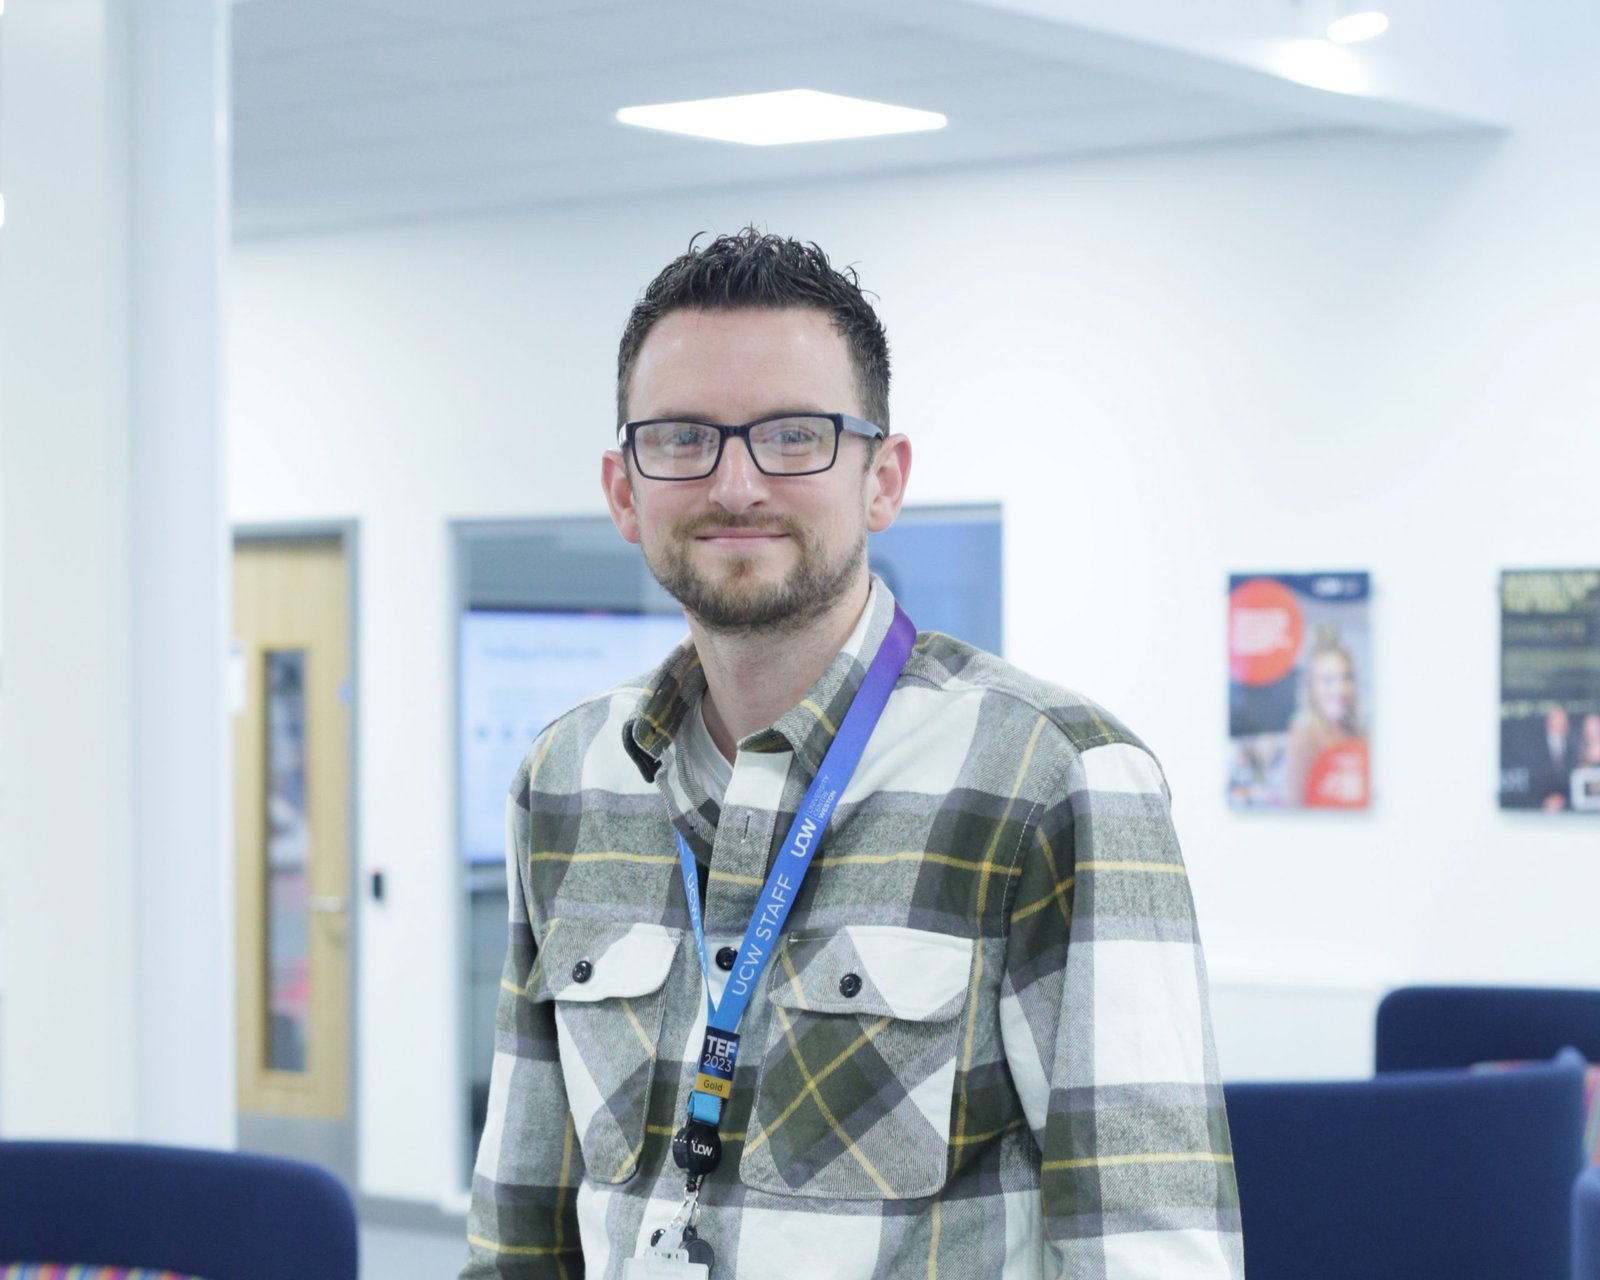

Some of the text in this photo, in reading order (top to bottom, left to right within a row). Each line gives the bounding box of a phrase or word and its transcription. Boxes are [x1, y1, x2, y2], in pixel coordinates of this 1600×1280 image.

[807, 774, 829, 814] UNIVERSITY
[813, 790, 829, 817] CENTRE
[818, 790, 837, 819] WESTON
[790, 817, 817, 858] UCW
[732, 873, 792, 996] UCW STAFF
[706, 1034, 737, 1059] TEF
[703, 1054, 732, 1073] 2023
[703, 1079, 723, 1093] Gold
